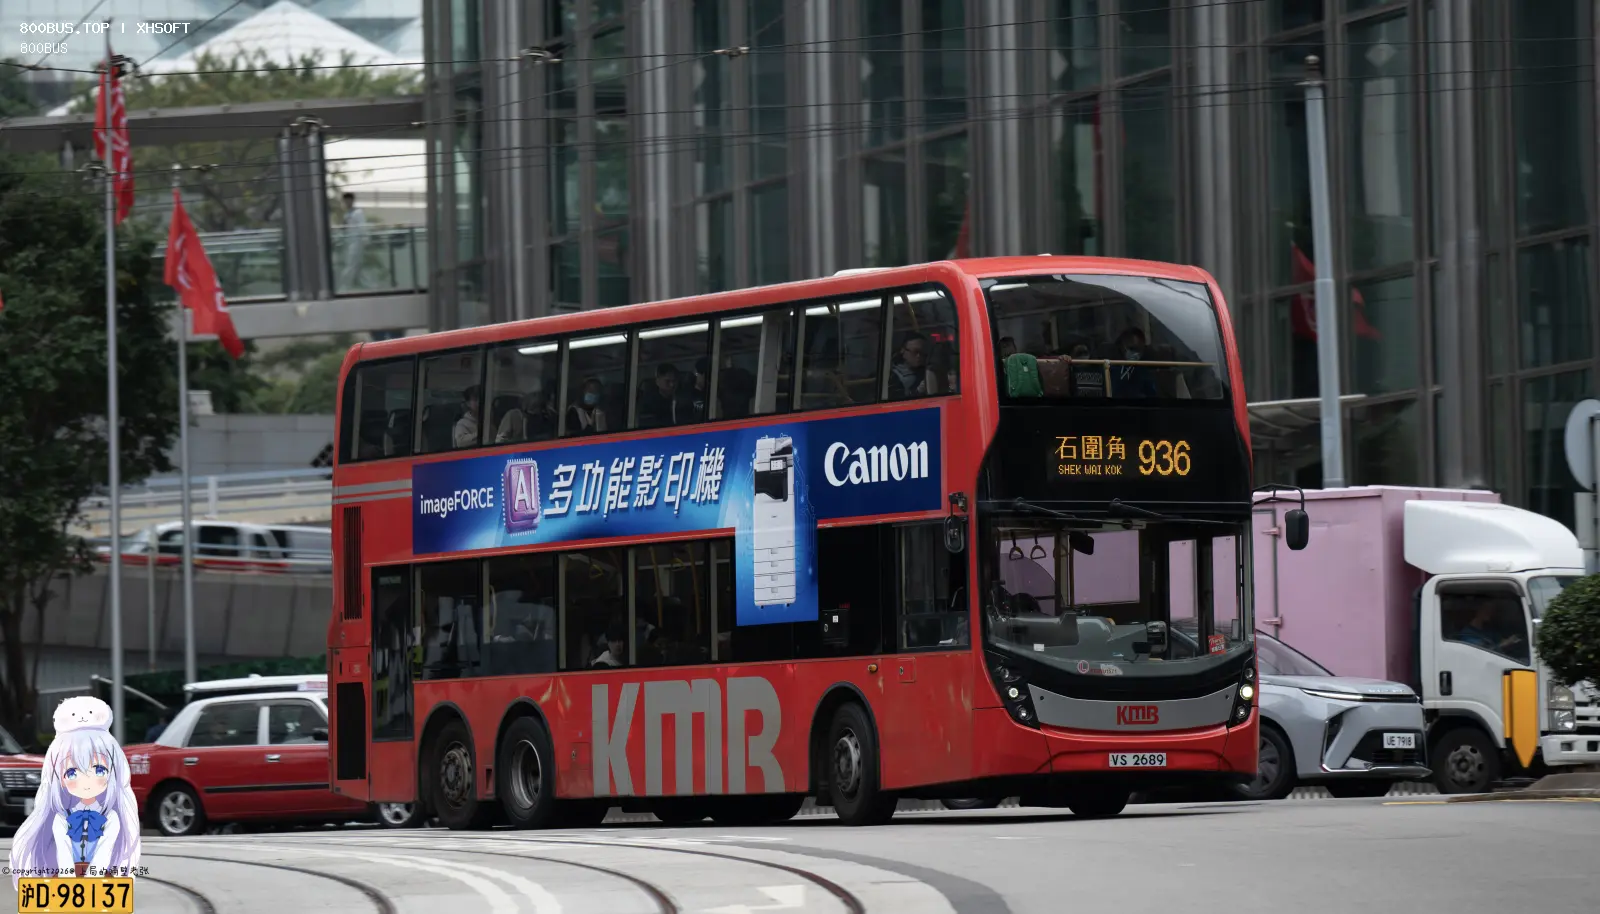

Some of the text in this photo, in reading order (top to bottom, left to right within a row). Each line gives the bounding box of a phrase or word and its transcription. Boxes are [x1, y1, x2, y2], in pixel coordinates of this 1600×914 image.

[1054, 435, 1126, 460] 石圍角
[1138, 440, 1191, 476] 936
[824, 440, 929, 487] Canon
[1058, 464, 1123, 475] SHEK WAI KOK
[420, 465, 536, 518] imageFORCE AI
[543, 443, 726, 518] 多功能影印機
[1116, 705, 1159, 725] KMB
[1386, 735, 1396, 746] UE
[1111, 754, 1165, 766] VS 2689
